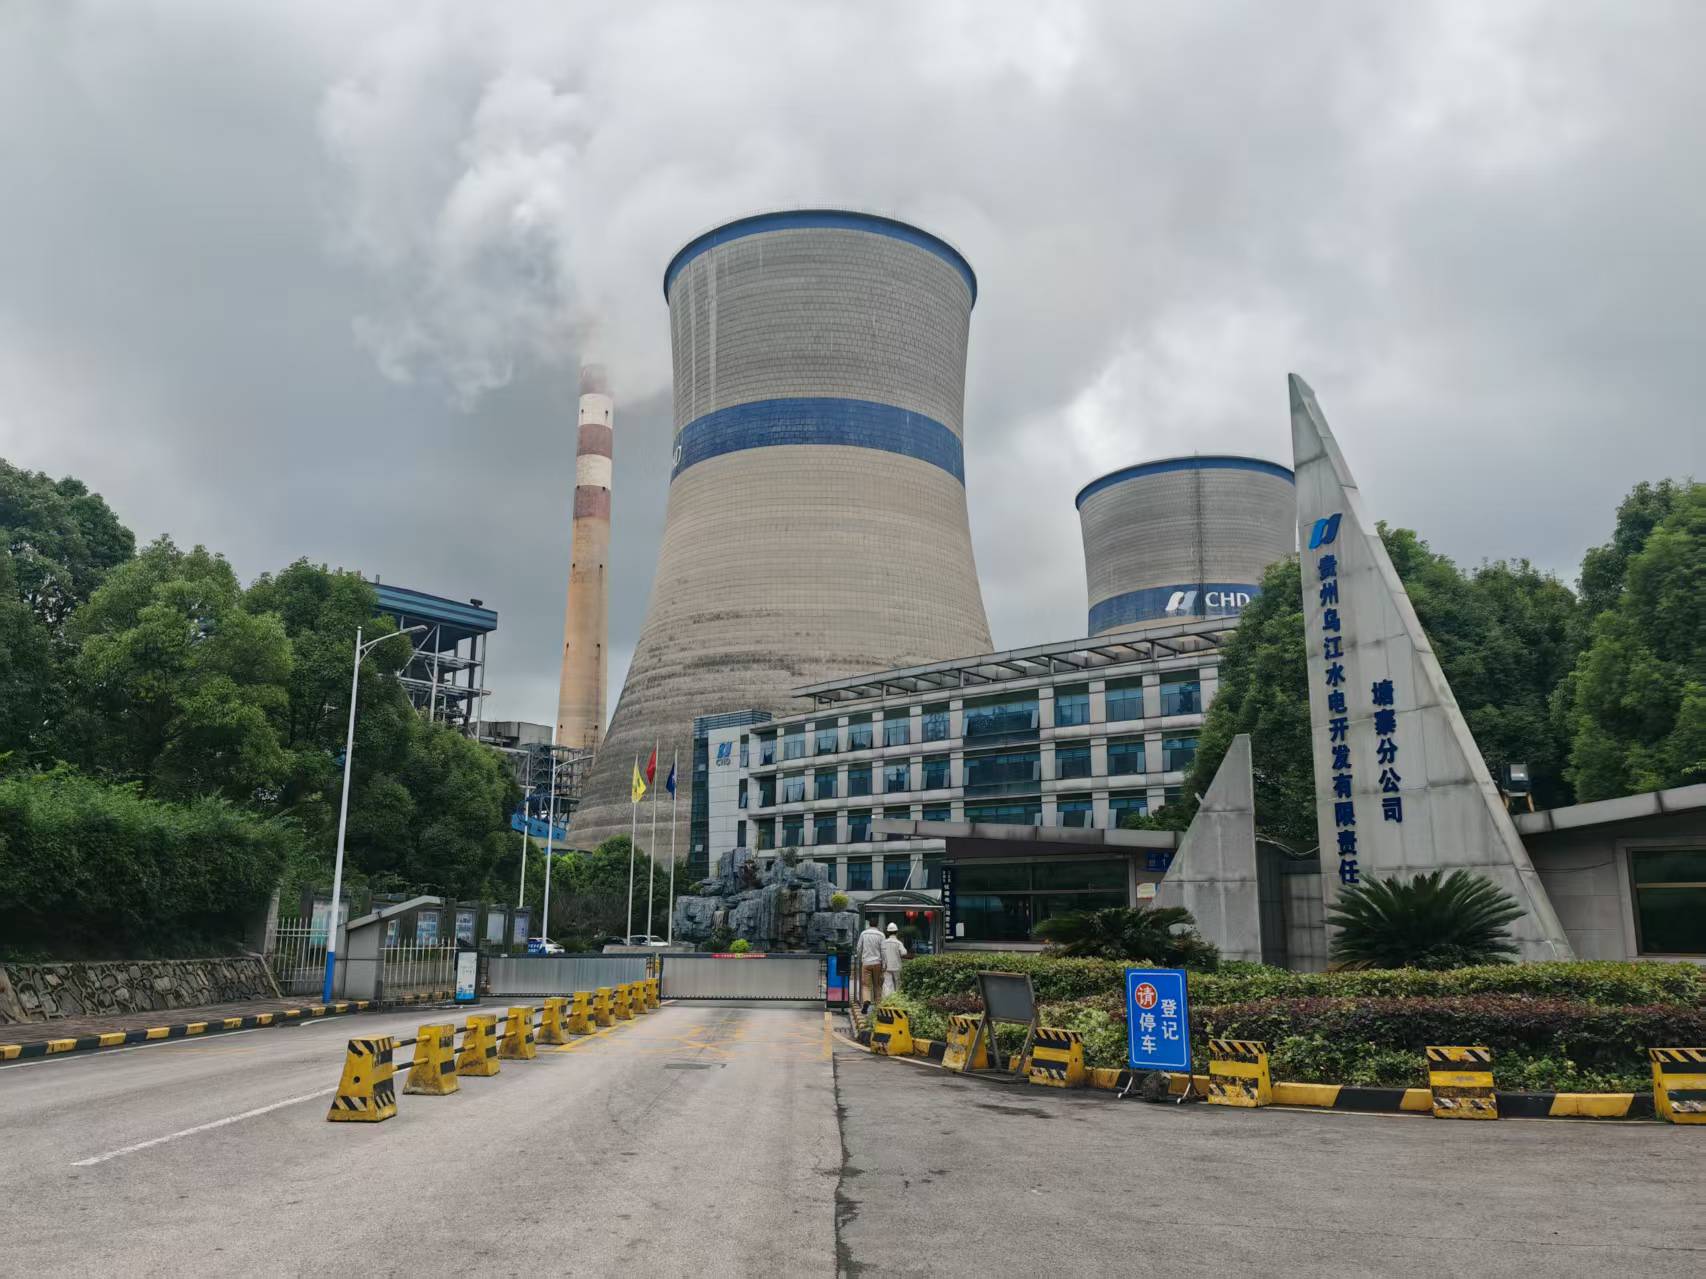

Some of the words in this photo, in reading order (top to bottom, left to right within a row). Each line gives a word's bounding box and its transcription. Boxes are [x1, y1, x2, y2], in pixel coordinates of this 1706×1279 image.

[1205, 591, 1250, 607] CHD
[1318, 555, 1359, 885] 贵州乌江水电开发有限责任
[1371, 679, 1403, 823] 塘寨分公司
[1160, 998, 1179, 1041] 登记
